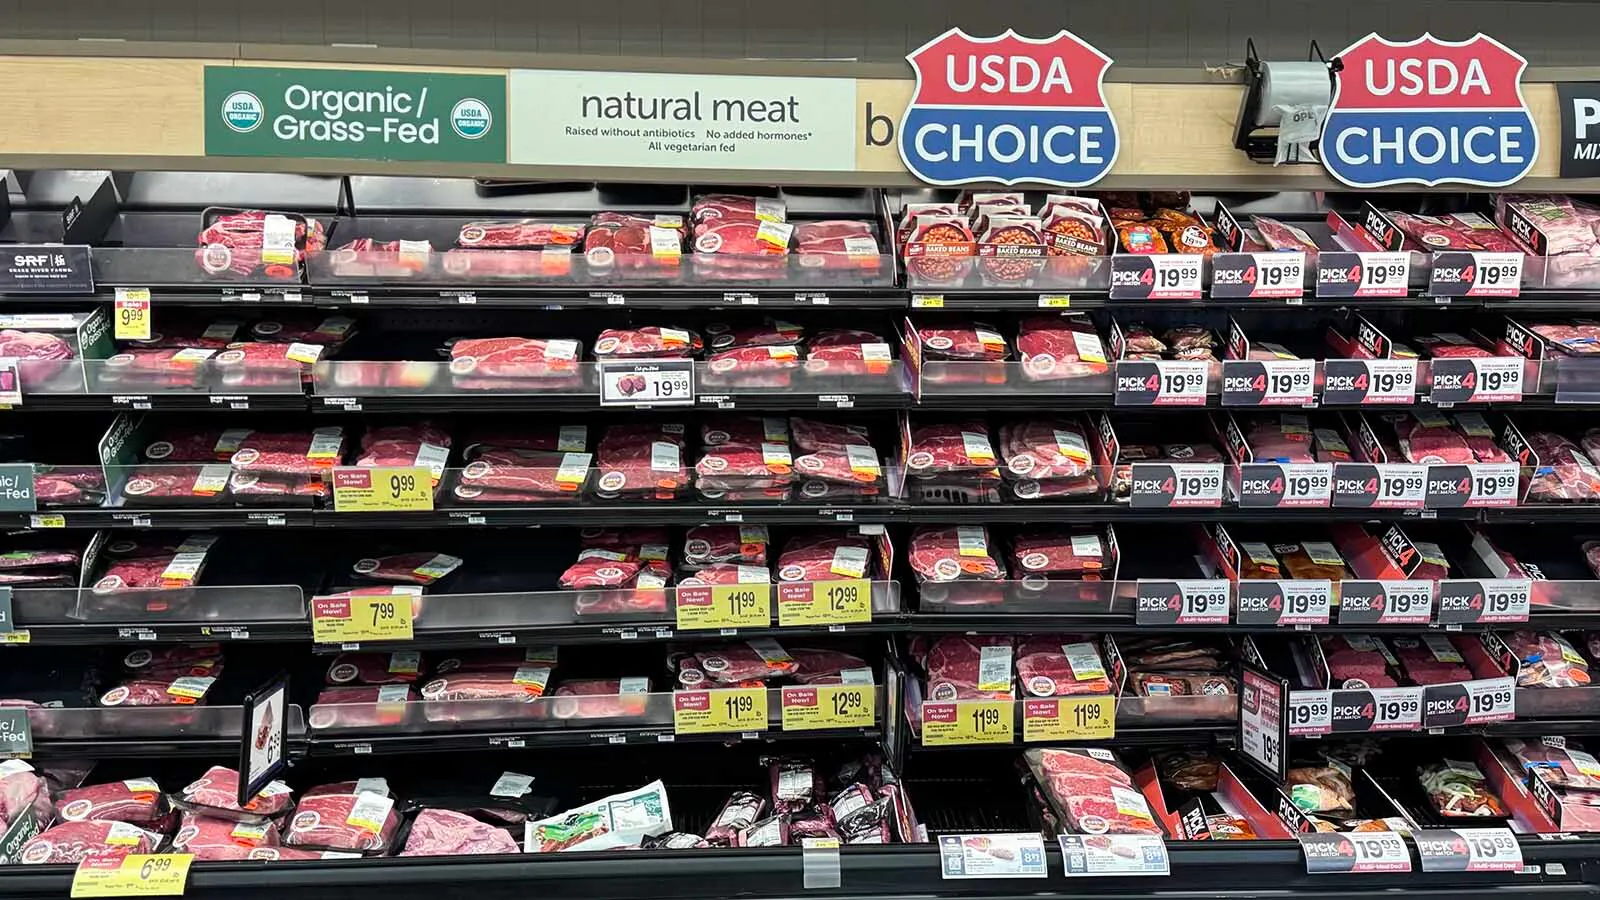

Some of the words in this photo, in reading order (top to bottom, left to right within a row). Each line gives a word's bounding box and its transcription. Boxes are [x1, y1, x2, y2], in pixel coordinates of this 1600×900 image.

[946, 54, 1073, 94] USDA
[1365, 58, 1492, 96] USDA
[231, 102, 254, 110] USDA
[284, 84, 412, 120] Organic
[416, 87, 428, 118] /
[581, 91, 701, 121] natural
[712, 95, 800, 123] meat
[461, 109, 482, 117] USDA
[273, 114, 439, 144] Grass-Fed
[565, 126, 598, 136] Raised
[600, 127, 640, 137] without
[643, 128, 695, 139] antibiotics
[706, 130, 721, 139] No
[723, 130, 755, 140] added
[865, 102, 894, 147] b
[648, 141, 662, 151] All
[664, 142, 717, 153] vegetarian
[719, 142, 735, 152] fed
[914, 122, 1104, 165] CHOICE
[1335, 125, 1525, 165] CHOICE
[1367, 210, 1386, 237] PICK
[1512, 213, 1530, 243] PICK
[1076, 241, 1098, 253] BEANS
[14, 255, 48, 267] SRF
[1113, 271, 1140, 281] PICK
[1140, 268, 1153, 285] 4
[1159, 268, 1198, 287] 1999
[1214, 270, 1242, 280] PICK
[1242, 266, 1256, 284] 4
[1261, 266, 1300, 285] 1999
[1320, 269, 1347, 279] PICK
[1347, 265, 1361, 282] 4
[1366, 265, 1405, 284] 1999
[1433, 269, 1461, 279] PICK
[1461, 265, 1474, 282] 4
[1479, 265, 1518, 284] 1999
[122, 309, 143, 326] 999
[653, 380, 688, 397] 1999
[1119, 377, 1146, 387] PICK
[1145, 374, 1159, 391] 4
[1165, 374, 1203, 393] 1999
[1225, 377, 1252, 387] PICK
[1252, 374, 1266, 391] 4
[1271, 374, 1310, 393] 1999
[1326, 376, 1354, 387] PICK
[1354, 374, 1368, 390] 4
[1373, 373, 1412, 392] 1999
[1434, 375, 1461, 385] PICK
[1461, 372, 1475, 389] 4
[1480, 371, 1519, 391] 1999
[1505, 425, 1523, 454] PICK
[391, 475, 415, 498] 999
[1134, 480, 1160, 490] PICK
[1161, 477, 1174, 494] 4
[1179, 477, 1219, 496] 1999
[1242, 480, 1270, 490] PICK
[1270, 477, 1284, 494] 4
[1290, 477, 1328, 496] 1999
[1337, 480, 1364, 490] PICK
[1364, 478, 1378, 494] 4
[1383, 478, 1423, 497] 1999
[1430, 481, 1456, 490] PICK
[1456, 477, 1470, 494] 4
[1476, 476, 1515, 496] 1999
[1385, 526, 1407, 552] PICK
[728, 591, 755, 615] 1199
[828, 587, 857, 610] 1299
[1140, 597, 1167, 607] PICK
[1167, 594, 1181, 610] 4
[1186, 594, 1225, 613] 1999
[1240, 597, 1268, 607] PICK
[1269, 594, 1282, 611] 4
[1288, 594, 1327, 613] 1999
[1343, 597, 1370, 606] PICK
[1370, 594, 1384, 610] 4
[1389, 594, 1428, 612] 1999
[1442, 596, 1469, 606] PICK
[1469, 593, 1482, 610] 4
[1488, 593, 1526, 612] 1999
[370, 602, 394, 627] 799
[725, 696, 752, 719] 1199
[831, 692, 861, 715] 1299
[1334, 706, 1361, 716] PICK
[1361, 703, 1375, 719] 4
[1380, 701, 1418, 720] 1999
[1427, 700, 1455, 710] PICK
[1455, 695, 1469, 712] 4
[1473, 692, 1511, 713] 1999
[972, 709, 999, 733] 1199
[1074, 704, 1100, 727] 1199
[1289, 704, 1328, 724] 1999
[1187, 807, 1205, 835] PICK
[1280, 798, 1300, 829] PICK
[1305, 842, 1335, 852] PICK
[1338, 840, 1353, 857] 4
[1356, 839, 1401, 859] 1999
[1421, 841, 1450, 851] PICK
[1451, 838, 1467, 854] 4
[1469, 837, 1514, 857] 1999
[140, 858, 172, 880] 699
